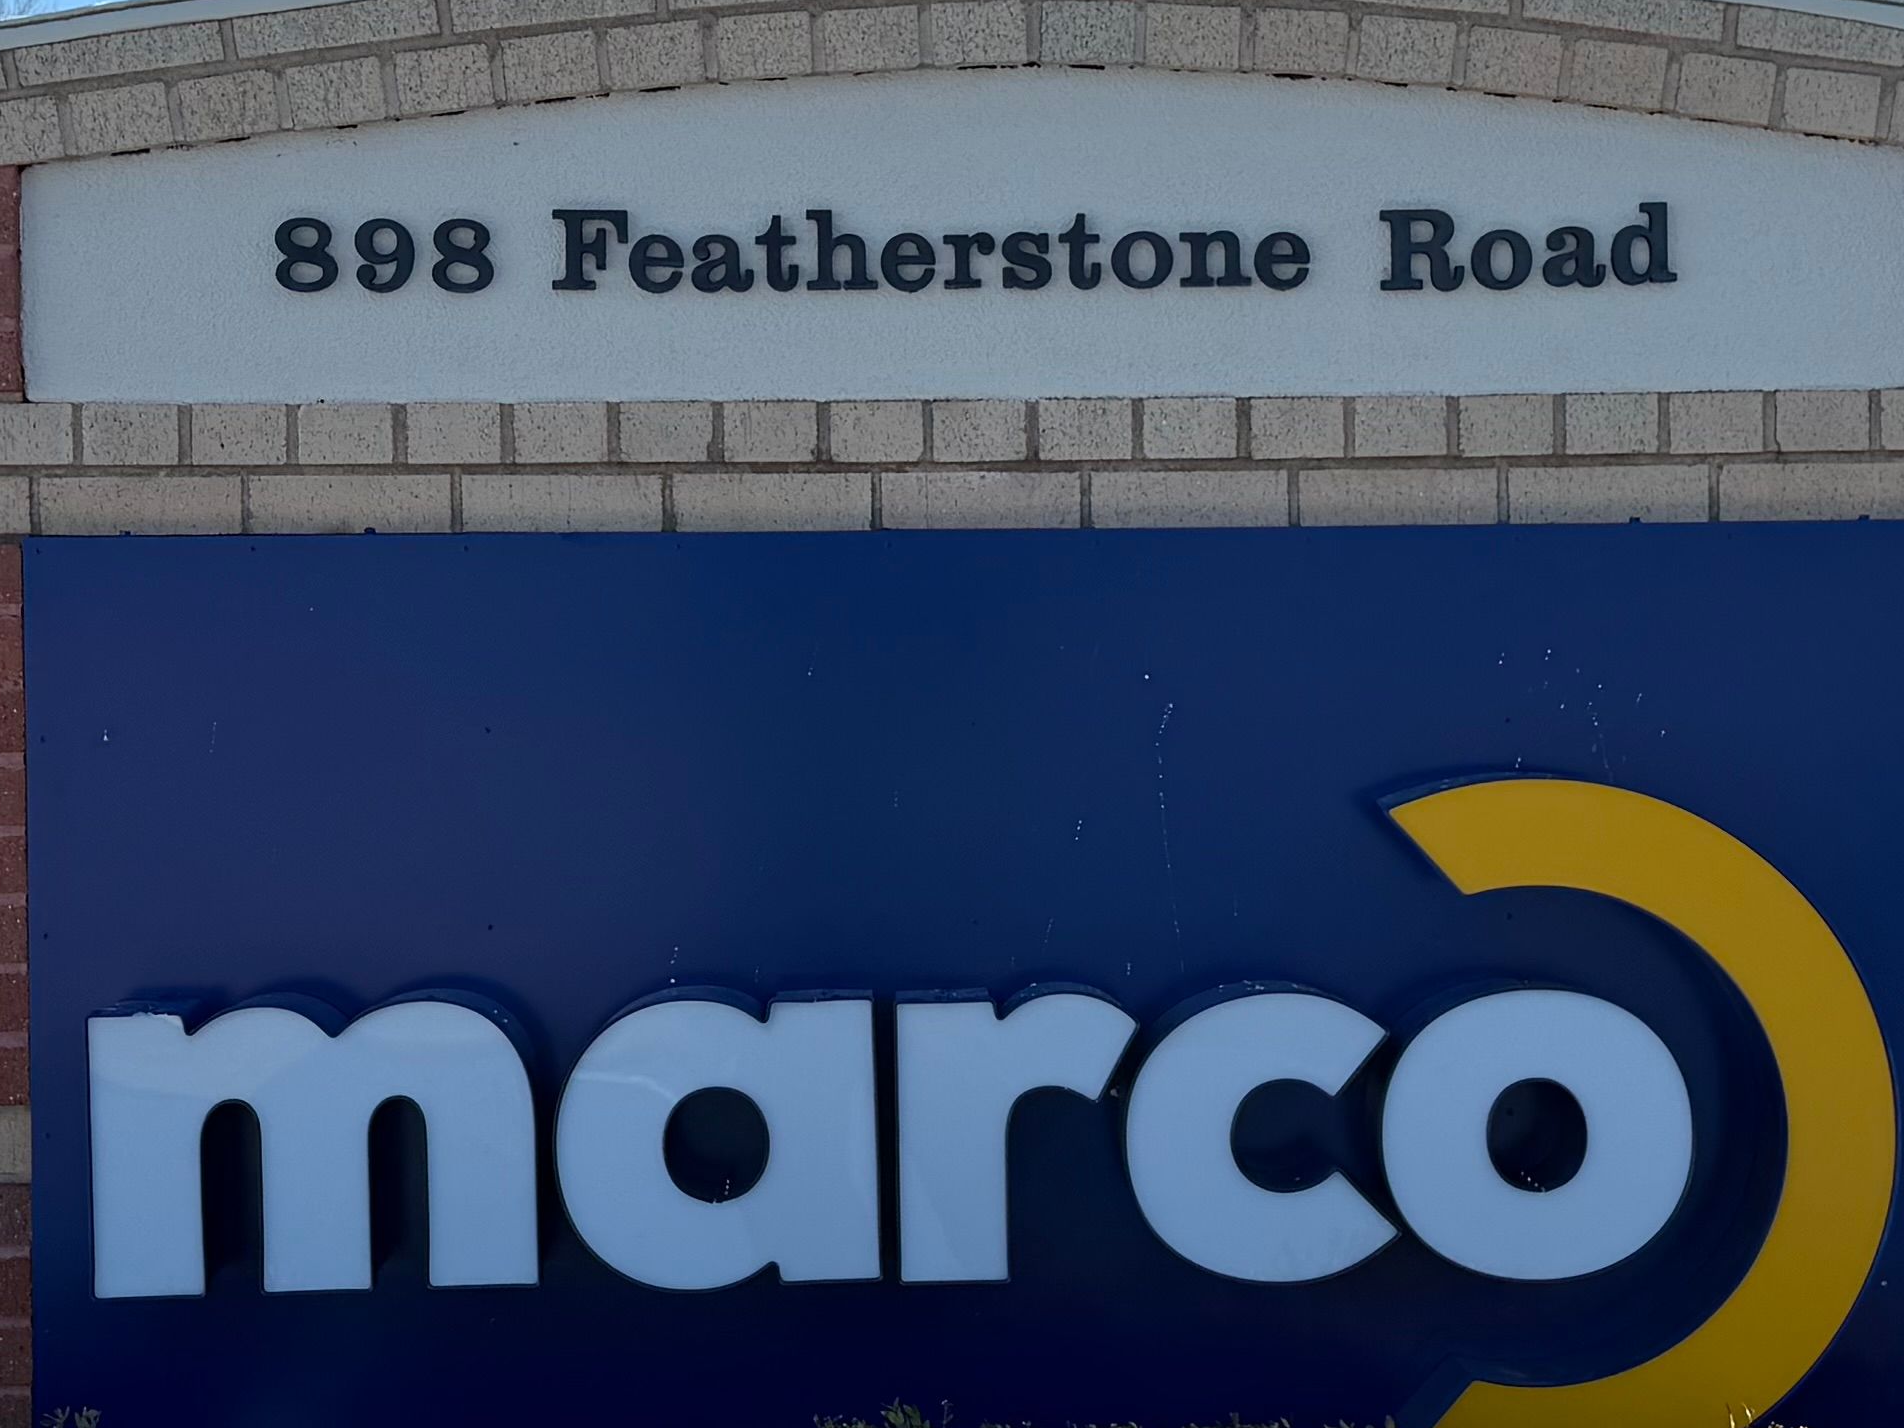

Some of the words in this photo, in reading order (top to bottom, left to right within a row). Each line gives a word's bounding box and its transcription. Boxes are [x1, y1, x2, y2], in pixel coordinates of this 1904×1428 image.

[274, 217, 495, 294] 898
[551, 208, 1311, 295] Featherstone
[1379, 201, 1678, 293] Road
[87, 988, 1694, 1299] marco
